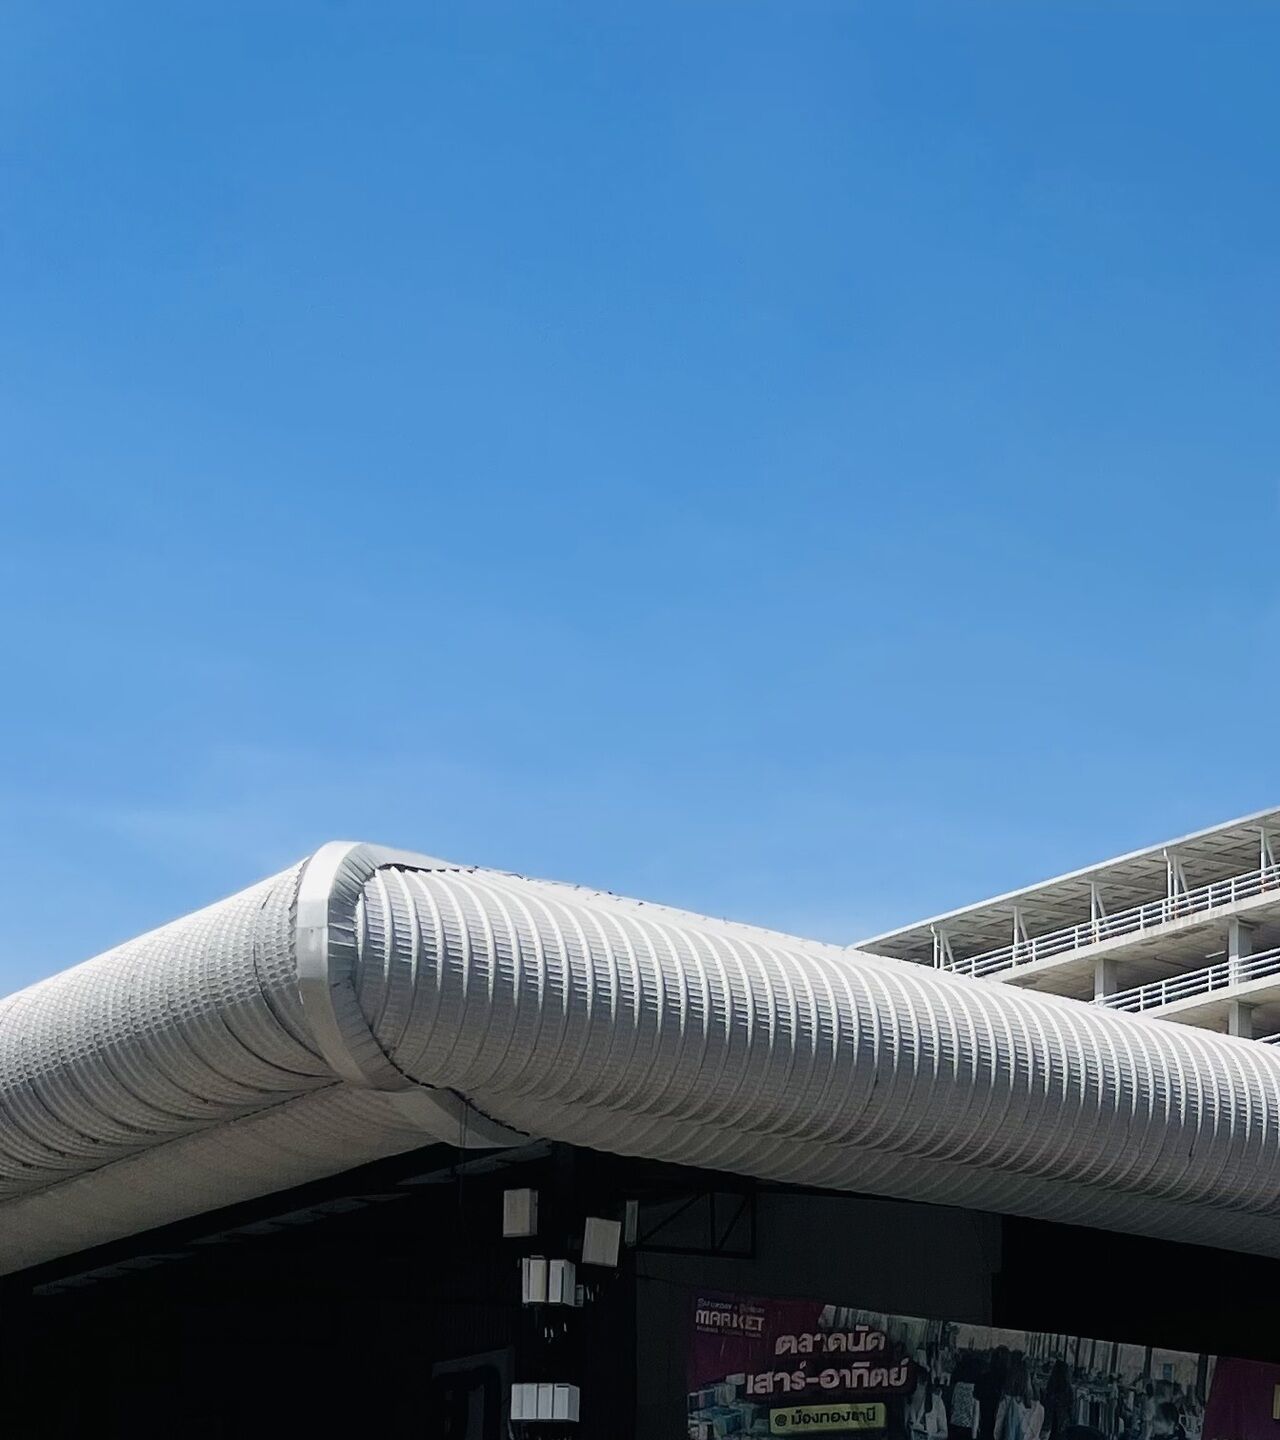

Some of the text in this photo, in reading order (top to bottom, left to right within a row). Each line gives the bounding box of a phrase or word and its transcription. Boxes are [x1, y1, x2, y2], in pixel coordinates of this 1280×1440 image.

[696, 1310, 765, 1331] MARKET
[774, 1325, 886, 1355] ตลาดนัด
[746, 1357, 909, 1394] เสาร์-อาทิตย์
